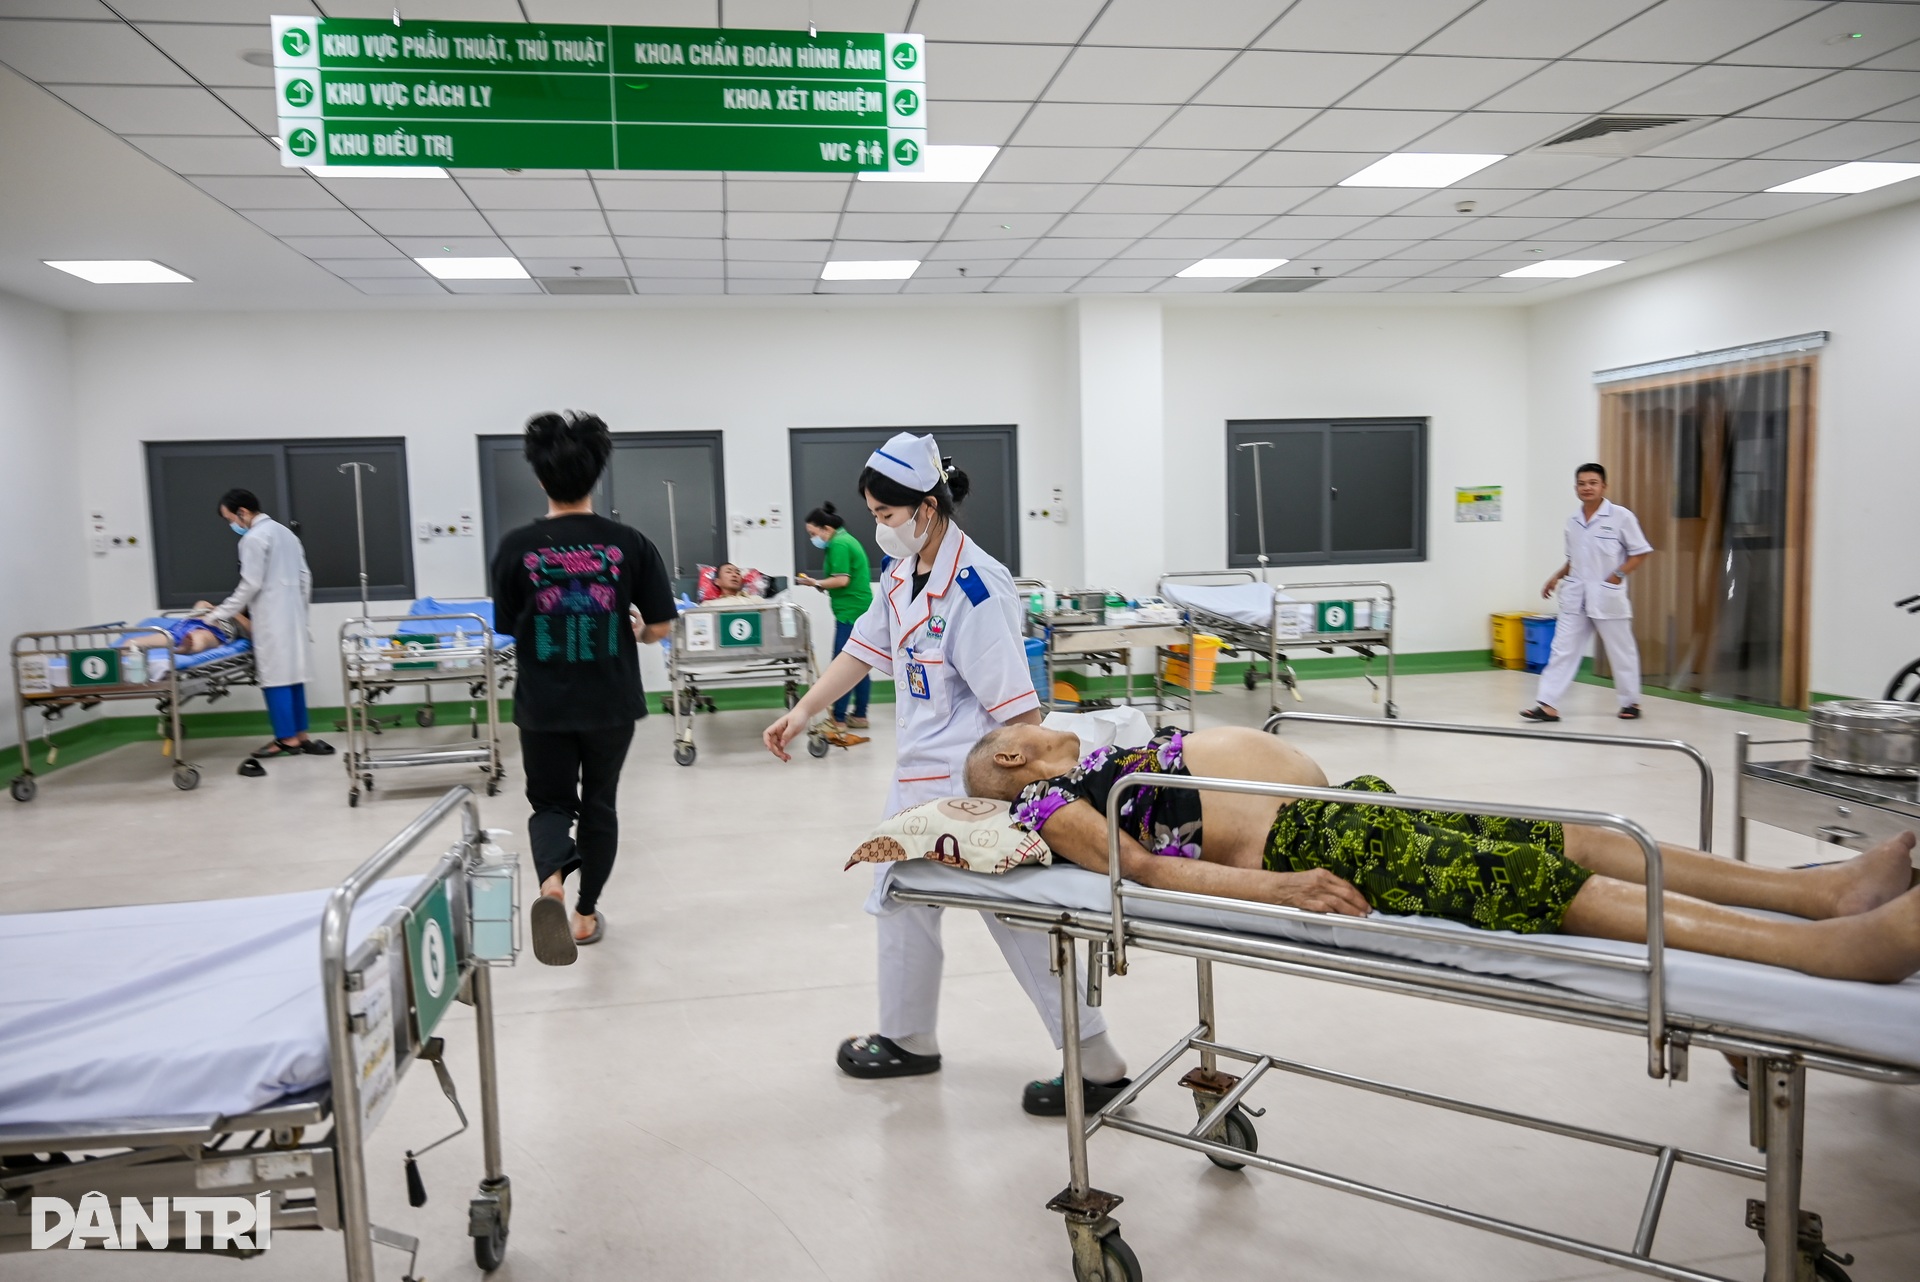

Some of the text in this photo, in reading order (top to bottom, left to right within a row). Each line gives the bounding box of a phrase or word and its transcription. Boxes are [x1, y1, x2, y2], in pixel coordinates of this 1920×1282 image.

[322, 28, 605, 67] KHU VỰC PHẪU THUẬT, THỦ THUẬT
[634, 37, 882, 70] KHOA CHẨN ĐOÁN HÌNH ẢNH
[325, 80, 492, 110] KHU VỰC CÁCH LY
[723, 85, 882, 116] KHOA XÉT NGHIỆM
[329, 127, 454, 161] KHU ĐIỀU TRỊ
[819, 142, 851, 162] WC
